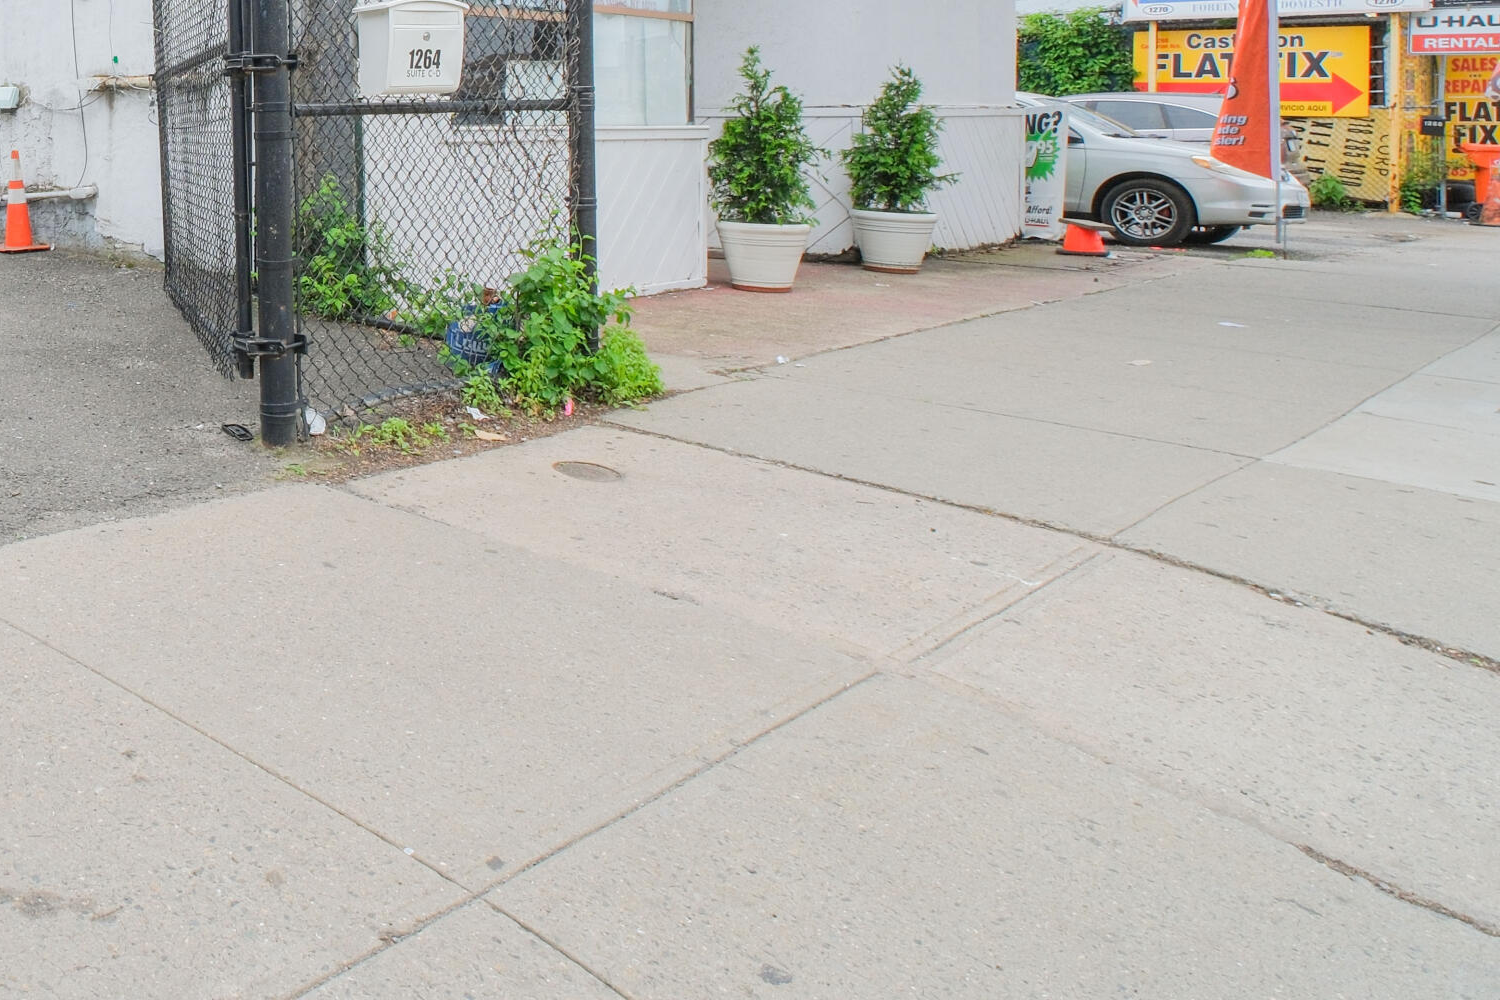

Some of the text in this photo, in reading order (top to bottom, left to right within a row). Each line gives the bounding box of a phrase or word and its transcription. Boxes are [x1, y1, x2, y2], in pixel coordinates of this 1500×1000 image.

[1280, 0, 1344, 9] DOMESTIC
[1424, 37, 1500, 48] RENTAL
[408, 48, 441, 70] 1264
[1279, 51, 1331, 78] IX
[1452, 57, 1497, 72] SALES
[406, 70, 441, 78] SUITE C-D
[1308, 104, 1327, 112] AQUI
[1454, 125, 1498, 144] FIX
